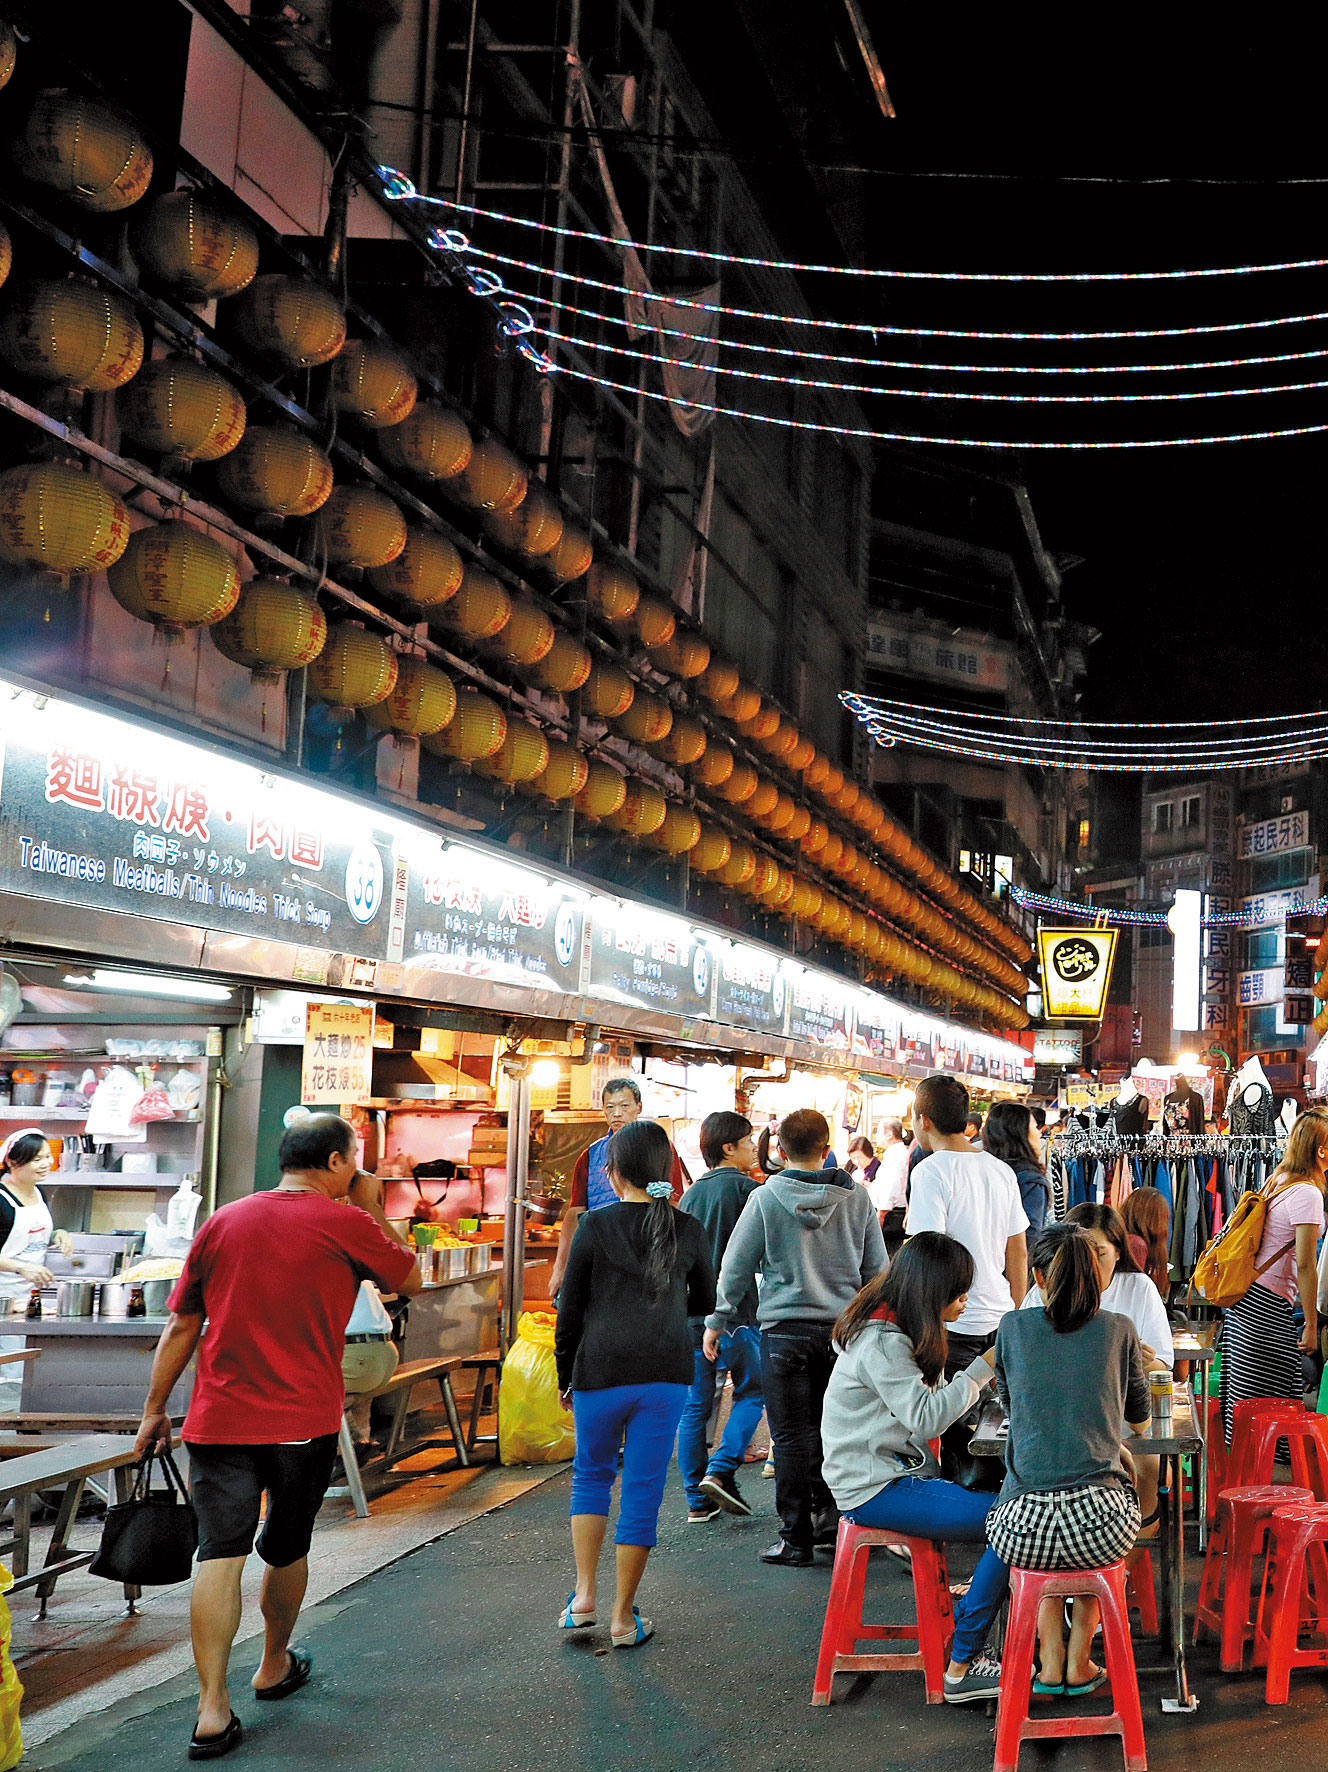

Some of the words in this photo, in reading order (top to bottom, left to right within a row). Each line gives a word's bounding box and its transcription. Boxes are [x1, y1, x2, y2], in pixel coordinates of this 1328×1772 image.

[19, 835, 106, 883] Taiwanese
[113, 856, 215, 906] Meatballs/Thin
[219, 884, 268, 917] Noodles
[273, 894, 302, 924] Thick
[305, 901, 332, 934] Soup
[391, 856, 409, 948] 隆廟口
[313, 1032, 352, 1059] 大麵炒
